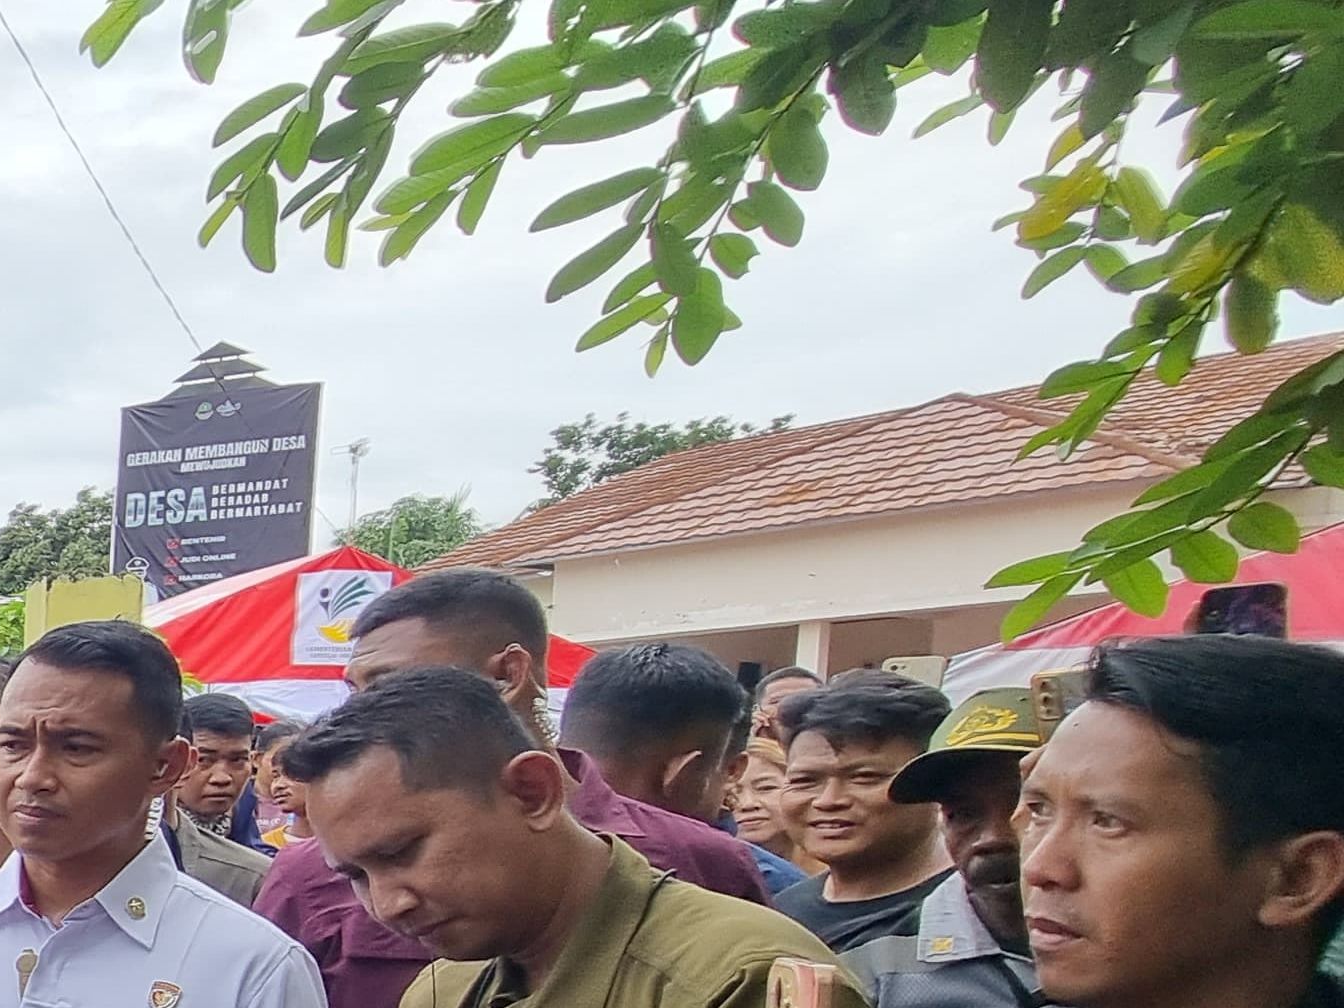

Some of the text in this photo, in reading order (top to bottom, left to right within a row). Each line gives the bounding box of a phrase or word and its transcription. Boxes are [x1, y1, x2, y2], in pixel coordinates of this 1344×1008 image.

[126, 435, 305, 467] GERAKAN MEMBANGUN DESA
[124, 486, 208, 528] DESA
[210, 502, 303, 520] BERMARTABAT
[211, 493, 269, 507] BERADAB
